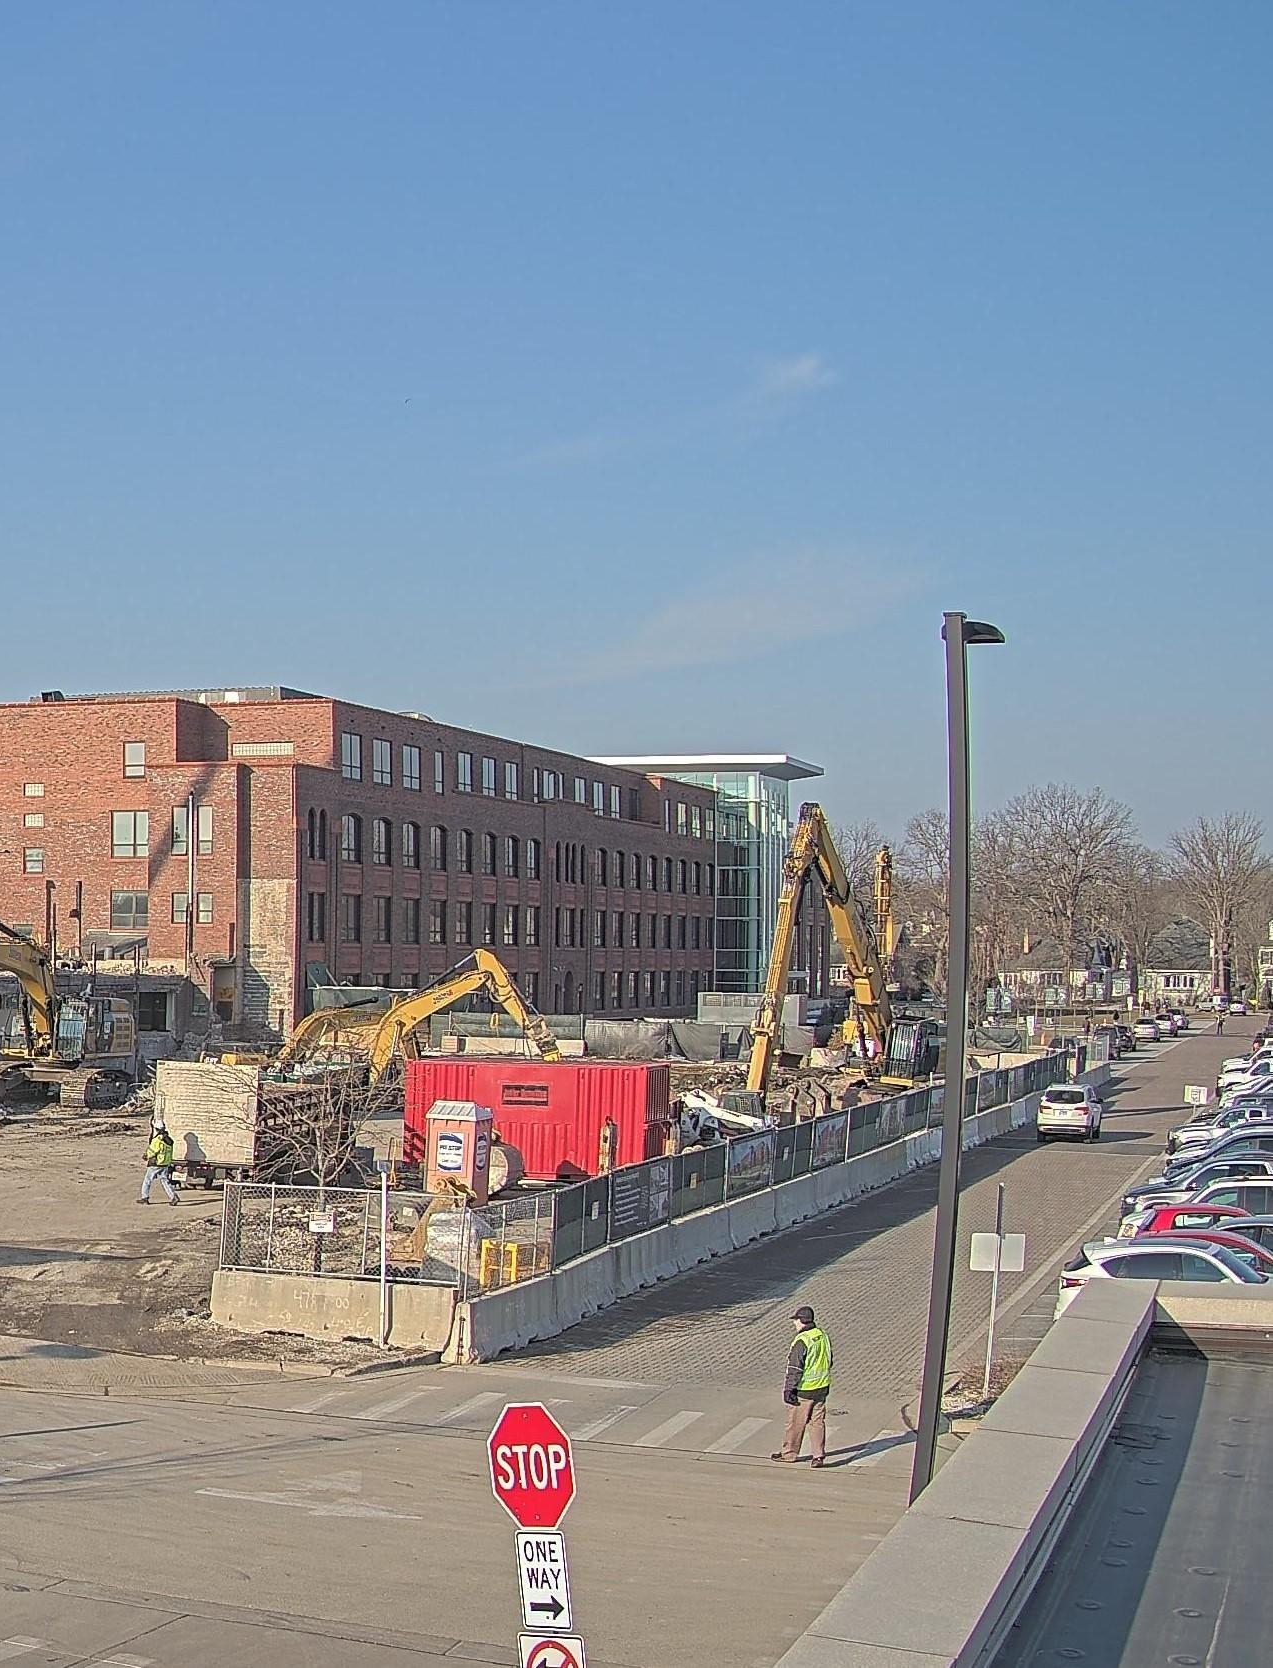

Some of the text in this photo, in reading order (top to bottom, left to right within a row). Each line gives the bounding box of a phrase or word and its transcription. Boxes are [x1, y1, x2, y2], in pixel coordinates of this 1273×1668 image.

[496, 1443, 567, 1491] STOP
[523, 1540, 559, 1563] ONE
[526, 1567, 561, 1590] WAY
